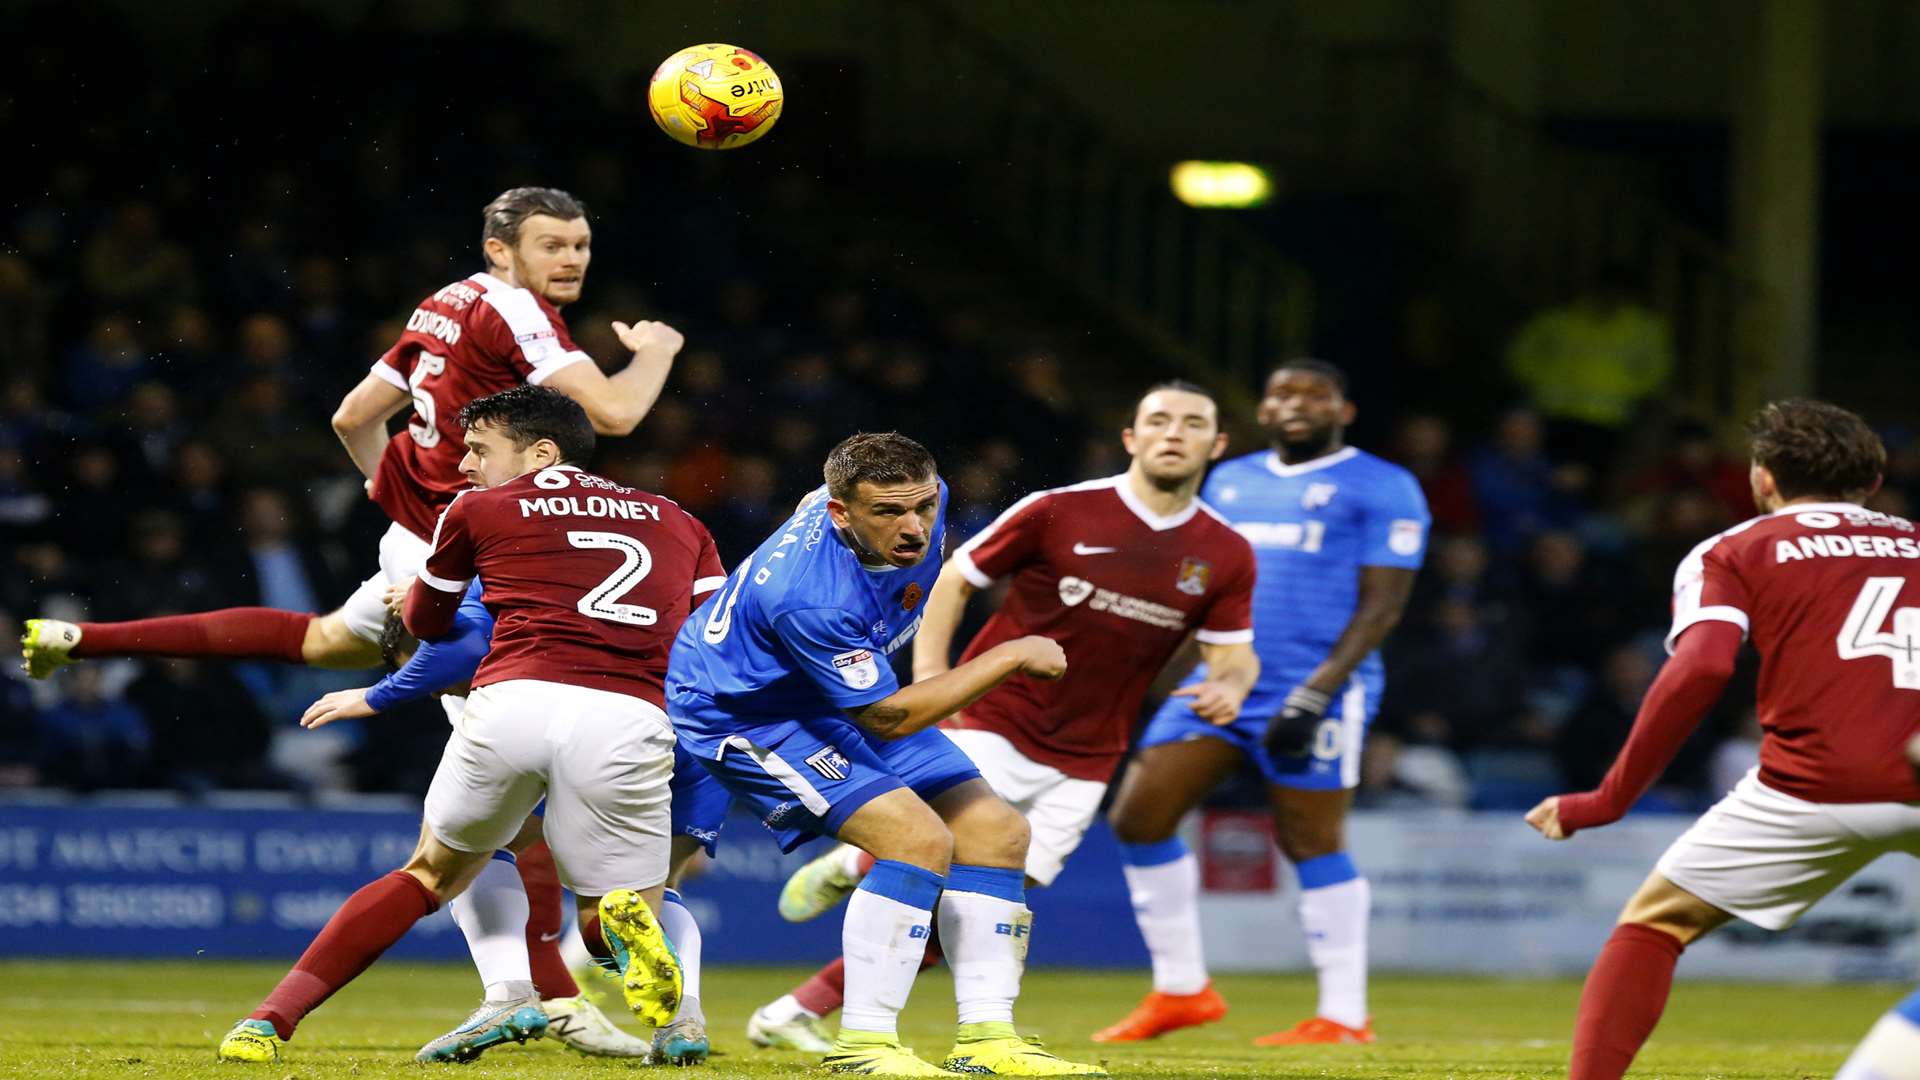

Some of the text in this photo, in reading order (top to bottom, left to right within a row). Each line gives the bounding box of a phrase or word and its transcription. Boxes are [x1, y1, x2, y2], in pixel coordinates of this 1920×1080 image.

[408, 350, 446, 449] 5
[518, 496, 661, 521] MOLONEY
[1776, 535, 1920, 564] ANDERS
[566, 531, 657, 625] 2
[1836, 576, 1920, 691] 4
